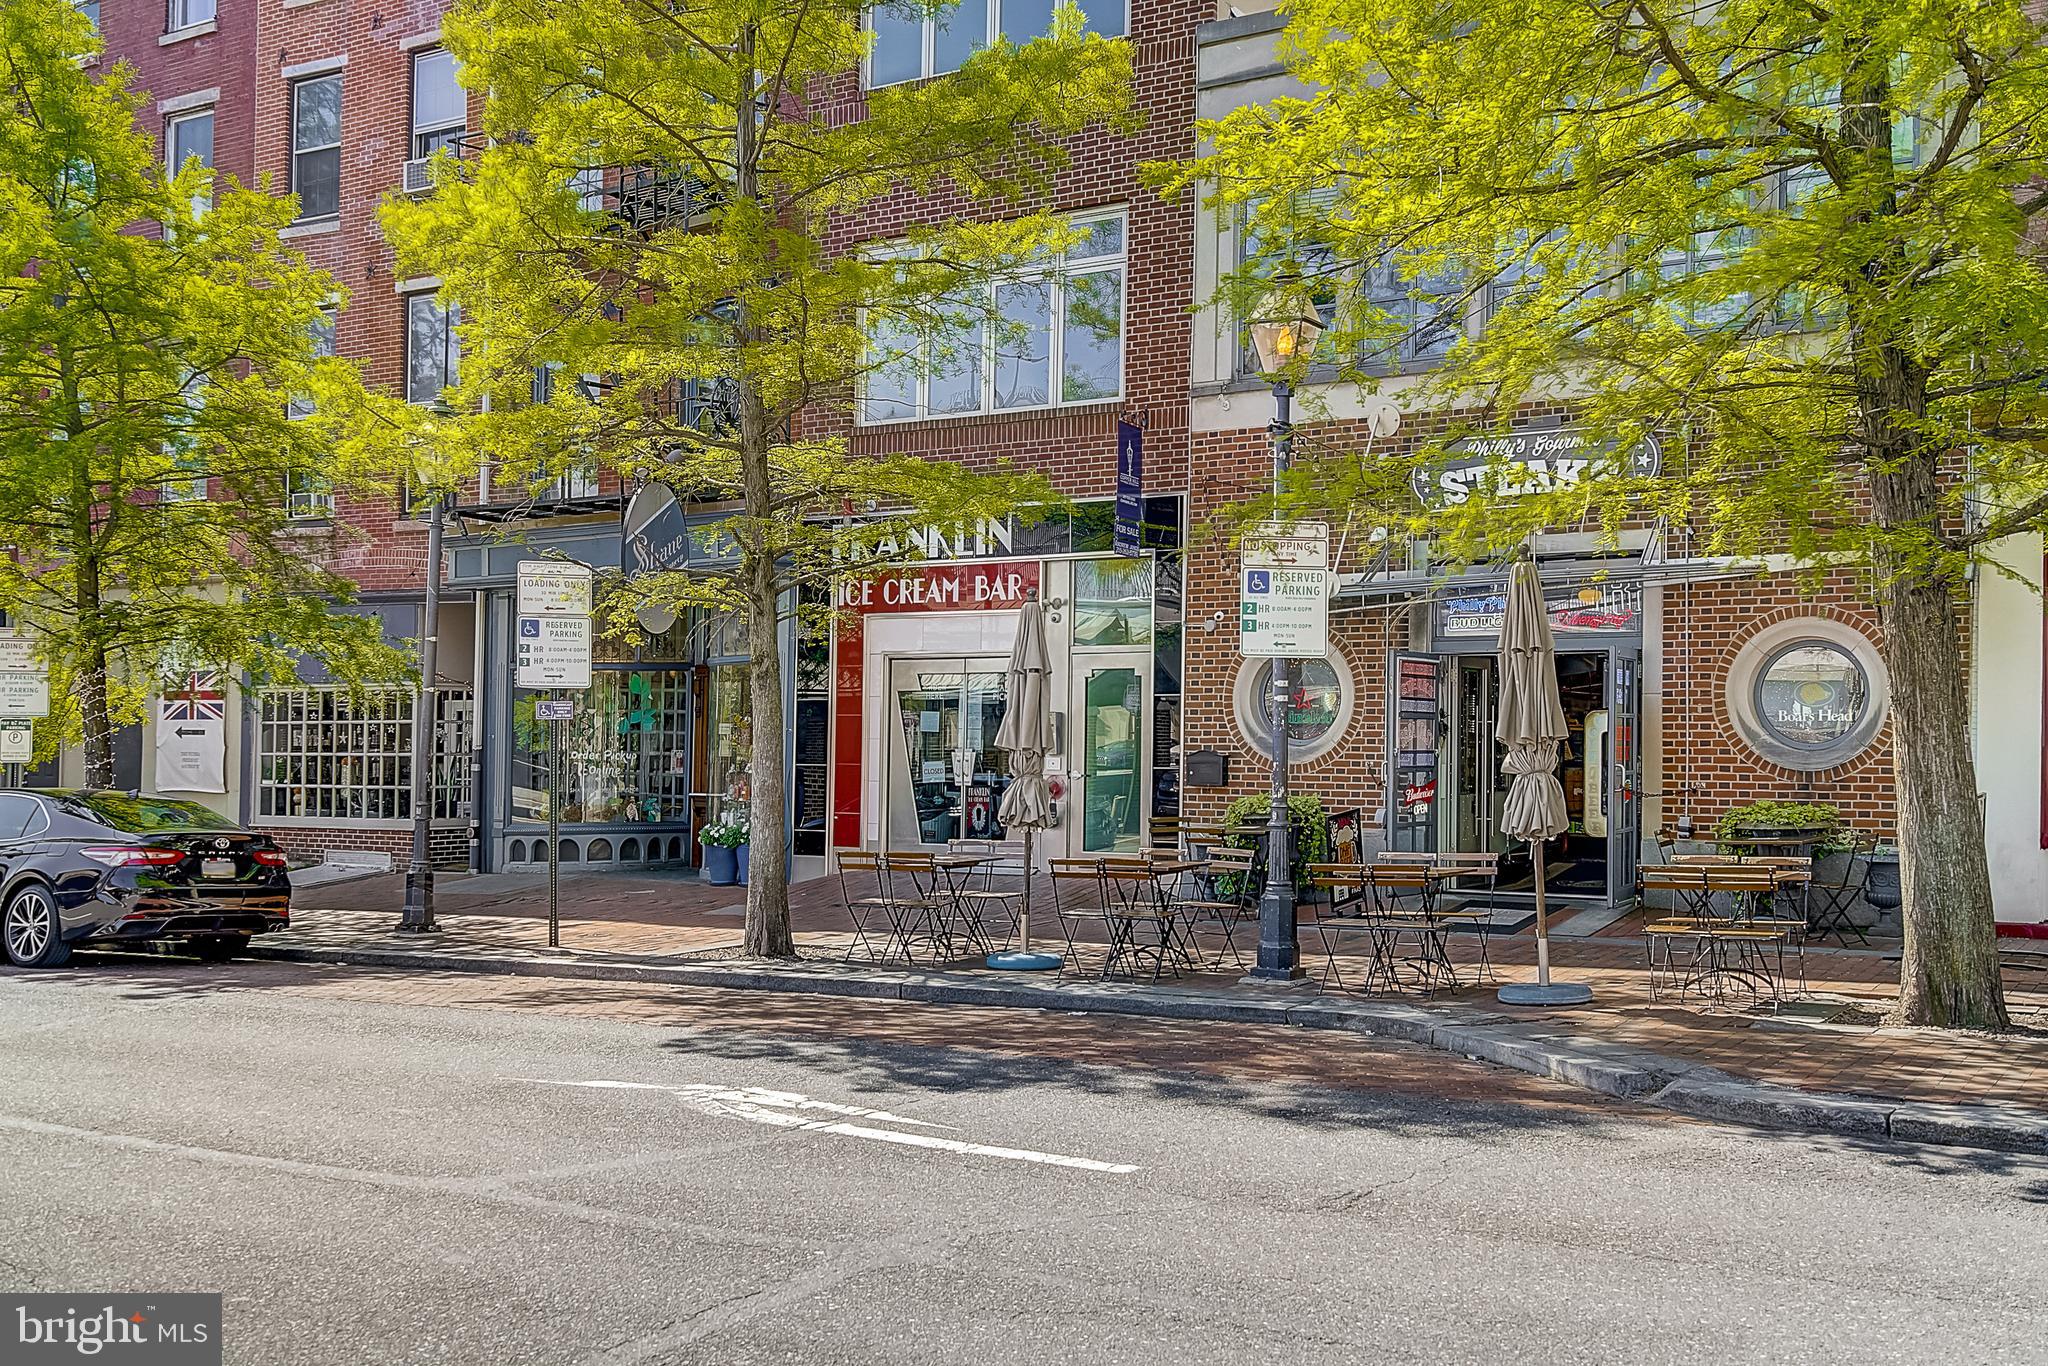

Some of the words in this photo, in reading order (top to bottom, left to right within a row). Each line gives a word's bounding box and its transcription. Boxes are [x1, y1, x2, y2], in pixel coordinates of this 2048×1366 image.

[1463, 436, 1526, 461] Philly's
[1531, 434, 1602, 457] Gourm
[1116, 525, 1127, 534] FOR
[1127, 527, 1139, 537] SALE
[1272, 571, 1323, 583] RESERVED
[523, 579, 560, 588] LOADING
[838, 580, 874, 607] ICE
[883, 576, 960, 606] CREAM
[974, 573, 1023, 602] BAR
[1275, 584, 1320, 596] PARKING
[1246, 603, 1253, 614] 2
[1258, 604, 1270, 614] HR
[545, 621, 583, 630] RESERVED
[1246, 620, 1253, 631] 3
[1258, 621, 1270, 631] HR
[1450, 617, 1480, 629] BUD
[1480, 615, 1505, 628] LIG
[550, 630, 583, 639] PARKING
[533, 645, 545, 653] HR
[522, 658, 528, 666] 3
[533, 657, 545, 665] HR
[9, 674, 39, 682] PARKING
[1818, 709, 1854, 722] Head
[570, 749, 600, 761] Order
[603, 748, 638, 767] Pickup
[923, 767, 944, 775] CLOSED
[1404, 788, 1435, 802] Budweiser
[1413, 803, 1428, 815] OPEN
